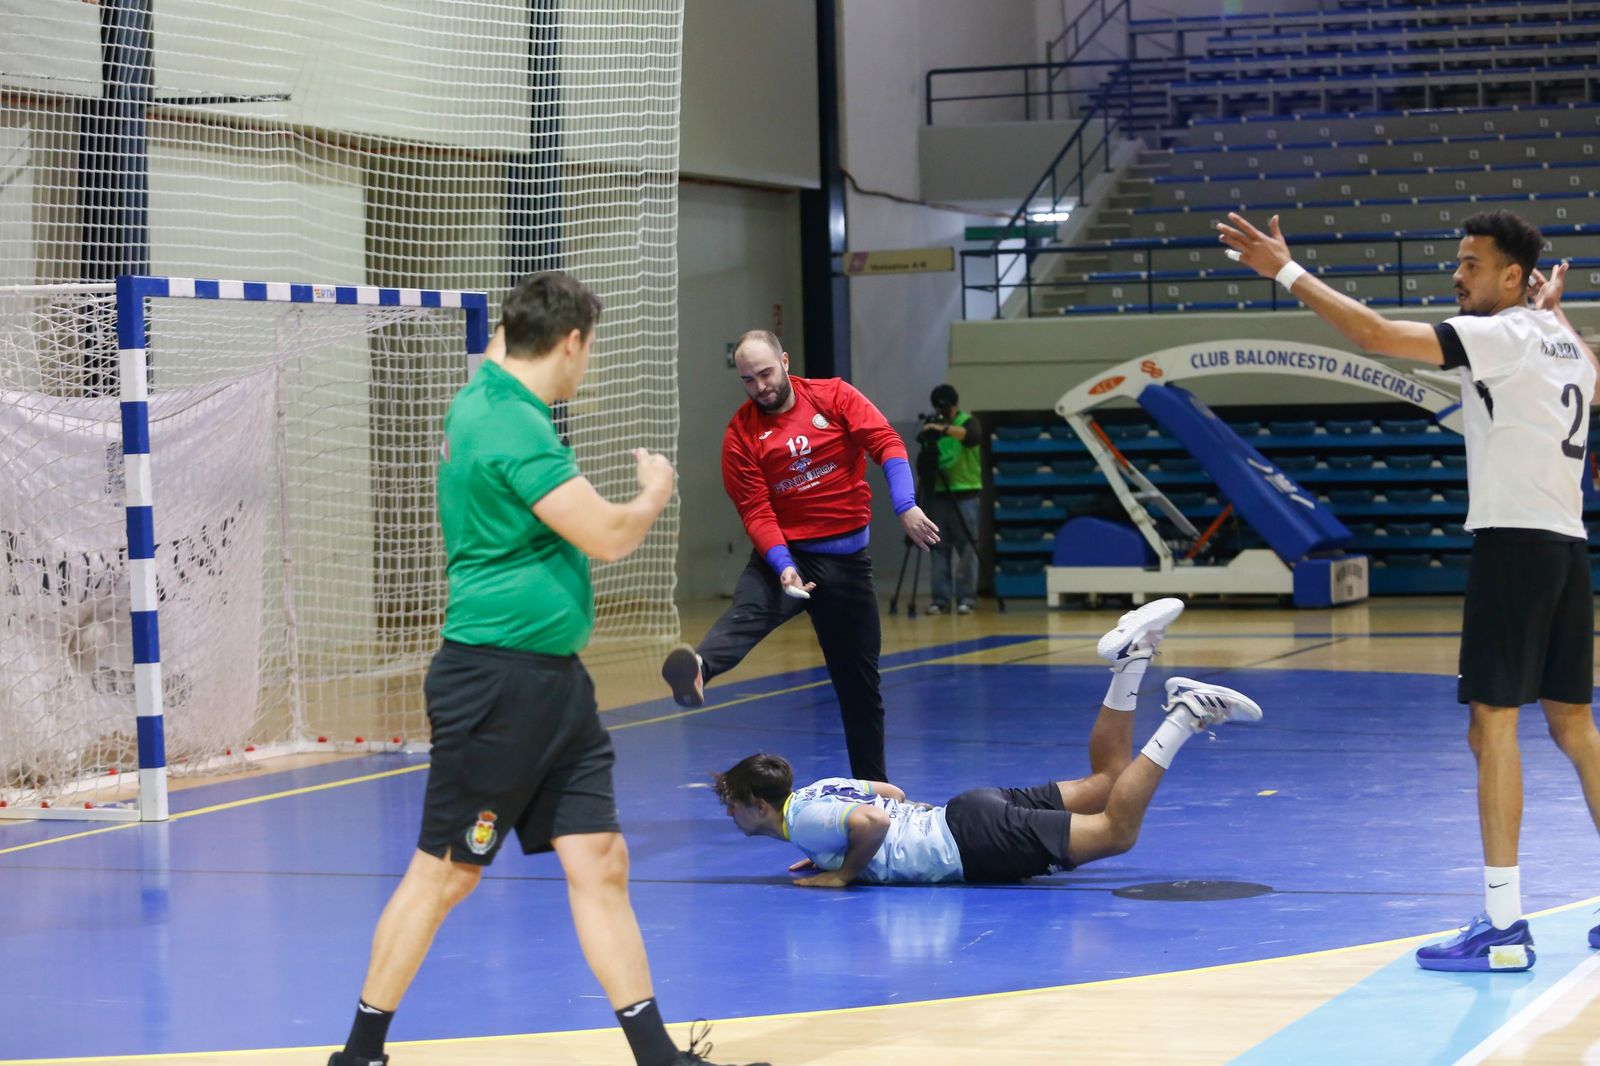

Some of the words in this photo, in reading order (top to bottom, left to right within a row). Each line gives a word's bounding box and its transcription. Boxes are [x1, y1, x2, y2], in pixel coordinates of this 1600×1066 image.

[1191, 350, 1229, 367] CLUB
[1237, 350, 1338, 372] BALONCESTO
[1342, 361, 1425, 404] ALGECIRAS
[786, 435, 812, 458] 12
[1561, 383, 1585, 460] 2
